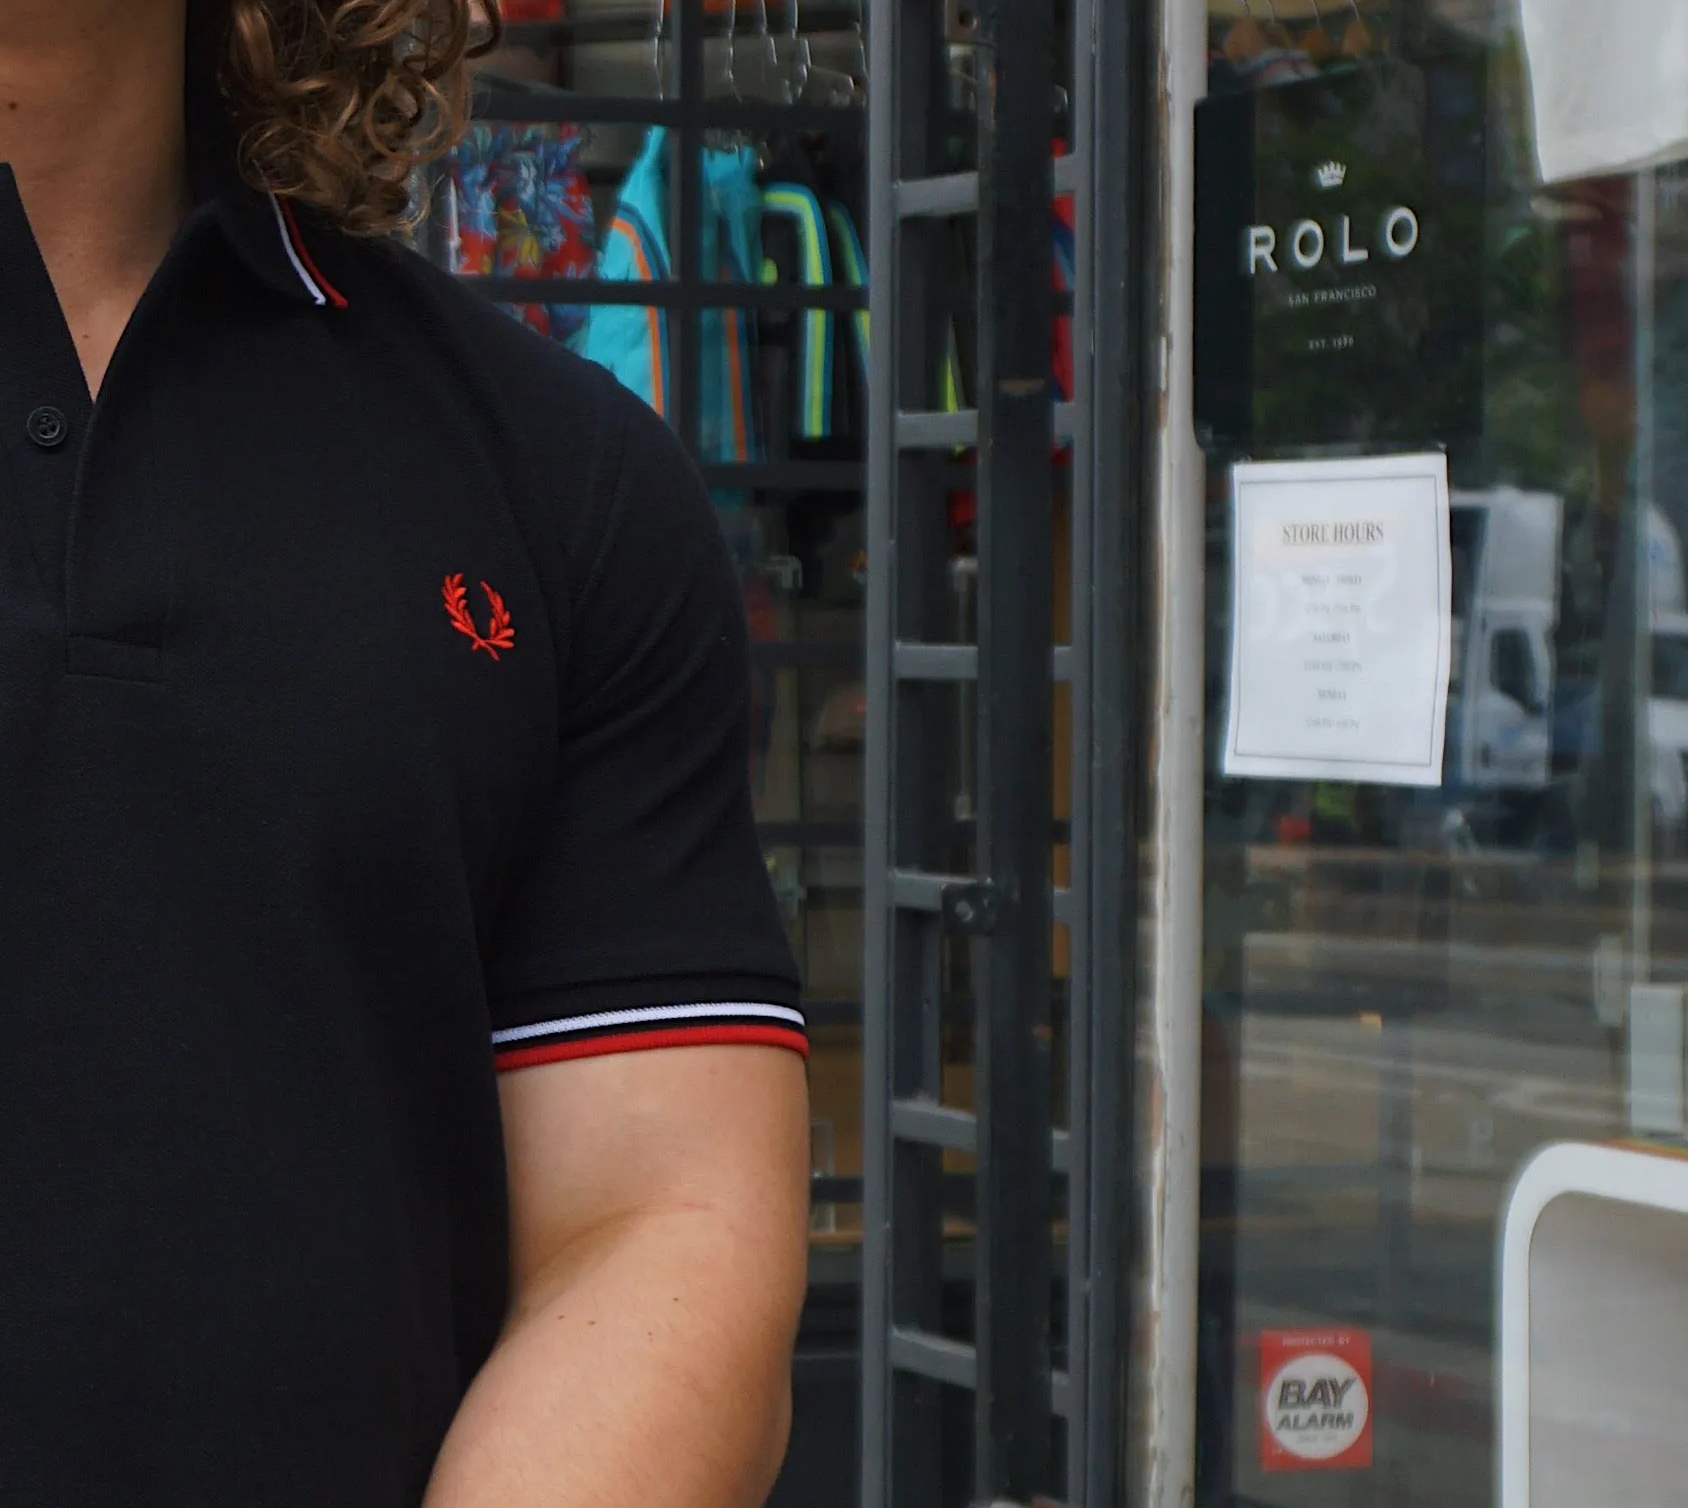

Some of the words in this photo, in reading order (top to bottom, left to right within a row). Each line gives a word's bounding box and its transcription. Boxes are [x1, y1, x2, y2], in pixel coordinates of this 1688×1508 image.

[1247, 205, 1419, 275] ROLO
[1287, 292, 1310, 308] SAN
[1313, 284, 1378, 303] FRANCISCO
[1281, 522, 1330, 543] STORE
[1334, 520, 1385, 543] HOURS
[1277, 1377, 1358, 1410] BAY
[1275, 1411, 1355, 1431] ALARM
